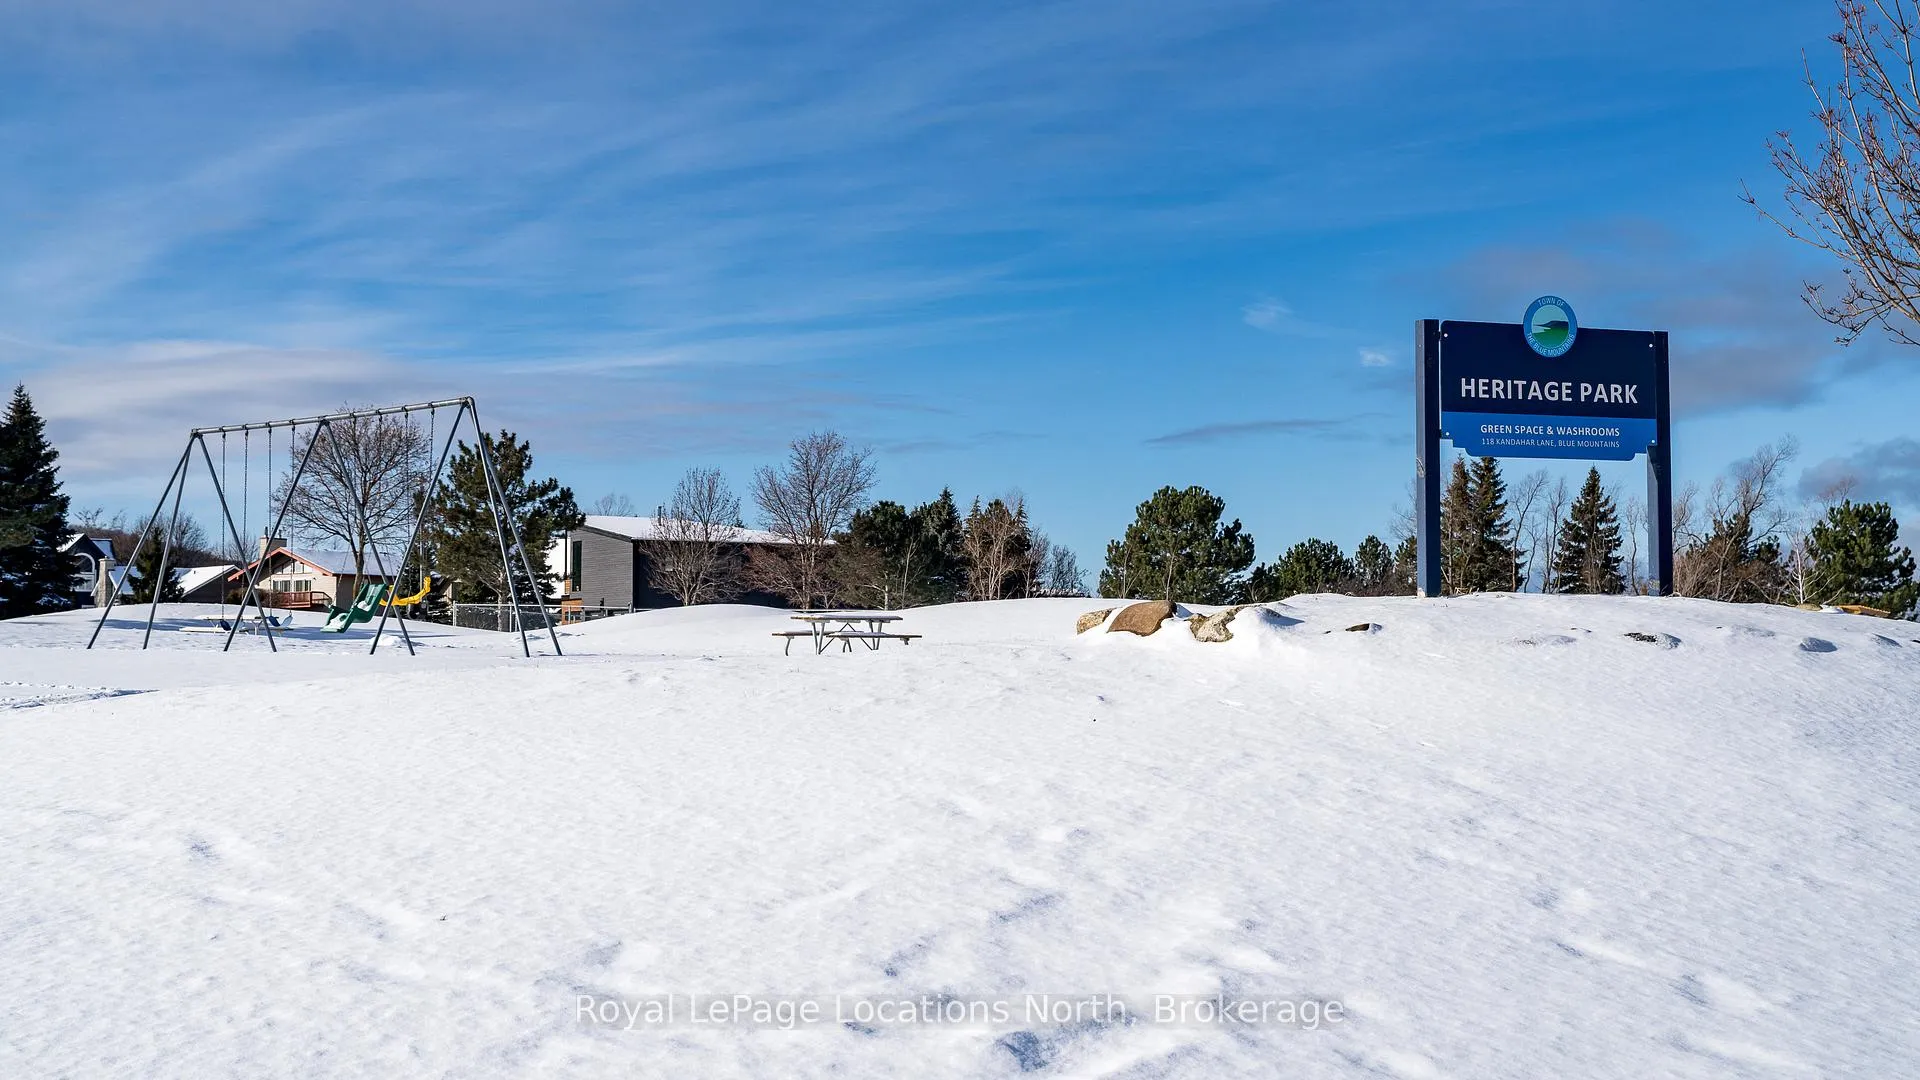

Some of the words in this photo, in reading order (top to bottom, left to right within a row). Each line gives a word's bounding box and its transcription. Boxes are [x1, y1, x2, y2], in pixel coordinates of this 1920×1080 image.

[1538, 298, 1555, 306] TOWN
[1556, 299, 1565, 307] OF
[1527, 332, 1535, 345] THE
[1534, 342, 1547, 355] BLUE
[1461, 378, 1572, 401] HERITAGE
[1580, 383, 1638, 404] PARK
[1480, 424, 1512, 434] GREEN
[1514, 425, 1544, 435] SPACE
[1546, 425, 1554, 435] &
[1556, 426, 1620, 437] WASHROOMS
[1496, 438, 1535, 446] KANDAHAR
[1536, 439, 1557, 447] LANE,
[1558, 439, 1576, 447] BLUE
[1577, 440, 1620, 448] MOUNTAINS
